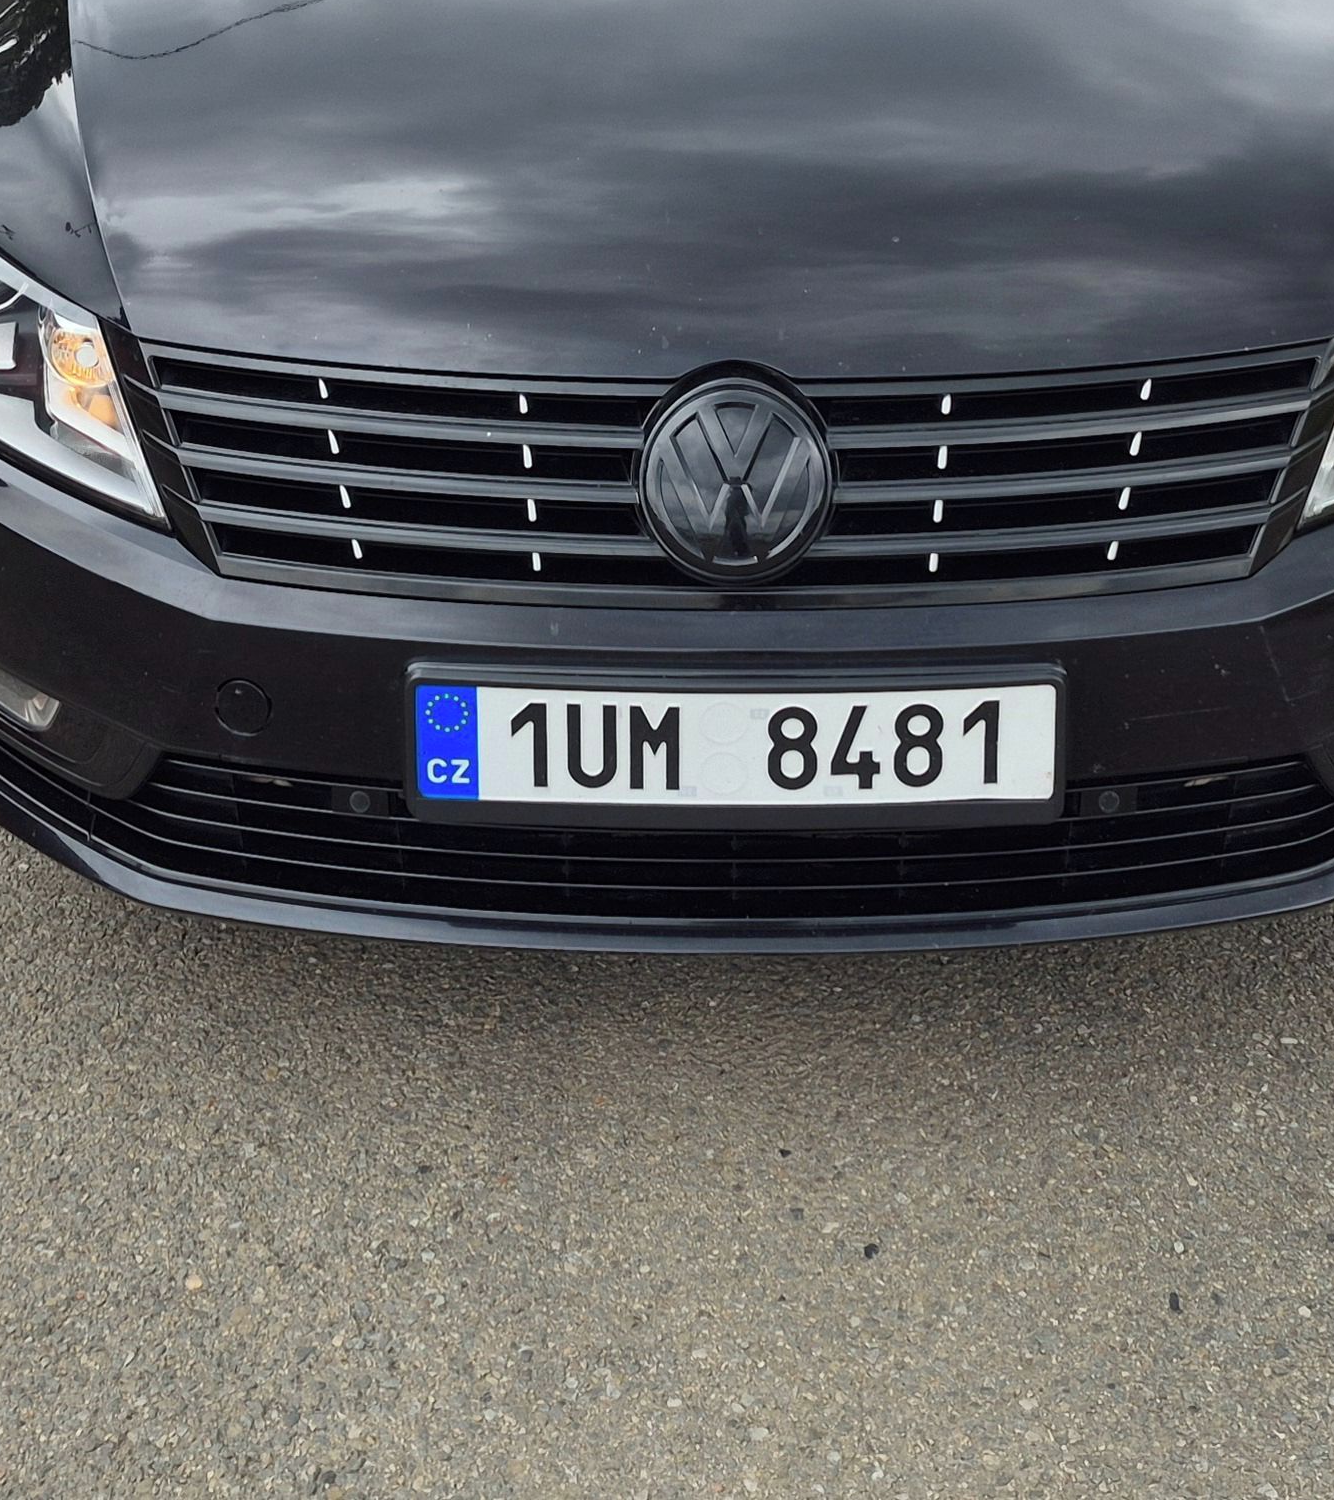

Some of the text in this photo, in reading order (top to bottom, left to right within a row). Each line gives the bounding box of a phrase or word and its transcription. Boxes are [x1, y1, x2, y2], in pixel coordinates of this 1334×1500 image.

[427, 700, 1000, 790] CZ 1UM 8481
